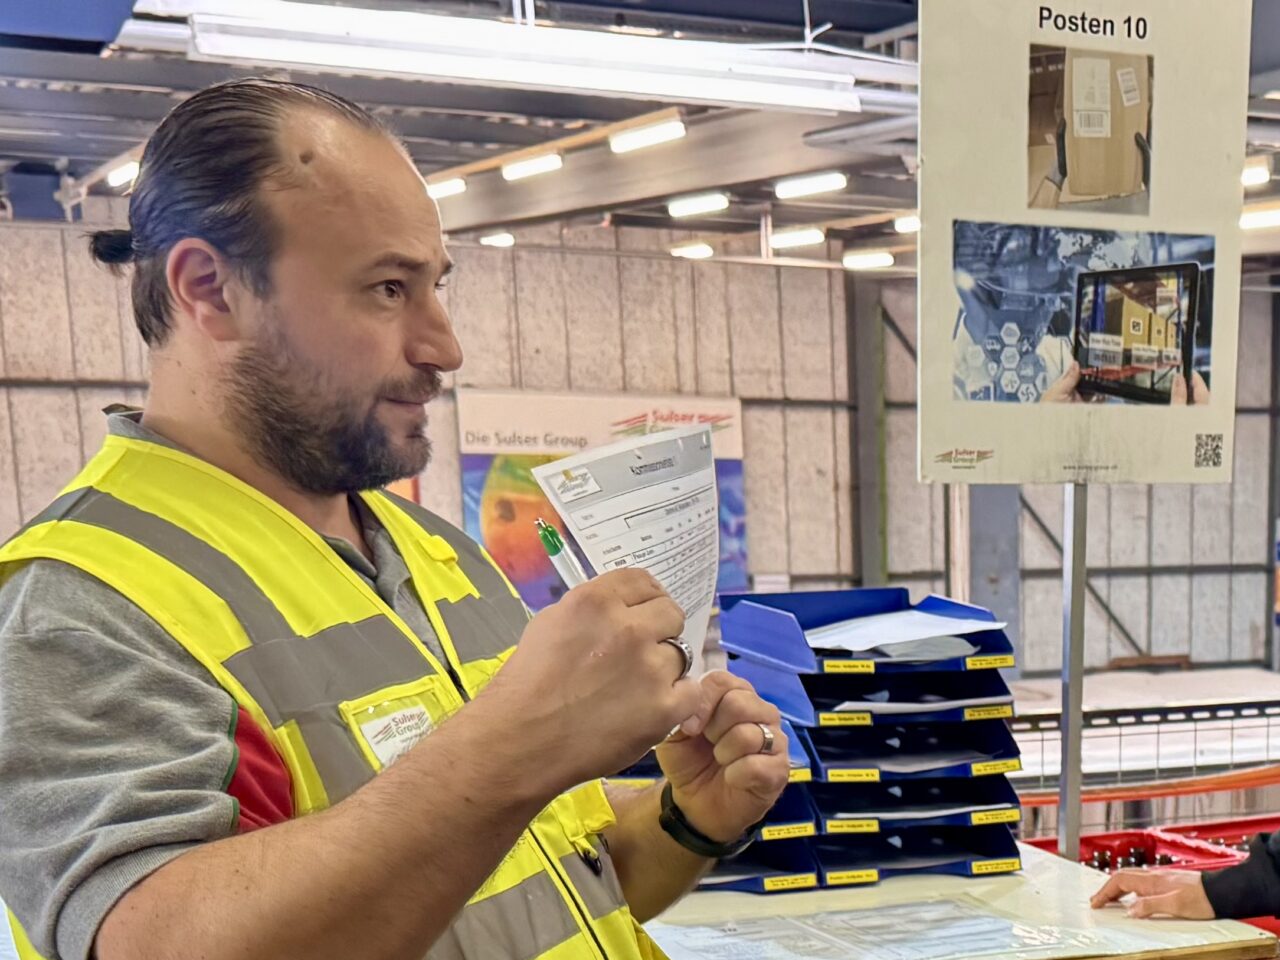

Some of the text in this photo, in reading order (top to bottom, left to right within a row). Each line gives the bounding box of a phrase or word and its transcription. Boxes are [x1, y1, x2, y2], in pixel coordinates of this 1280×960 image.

[1039, 6, 1148, 40] Posten 10
[651, 409, 695, 424] Sulser
[465, 431, 488, 446] Die
[543, 432, 588, 449] Group
